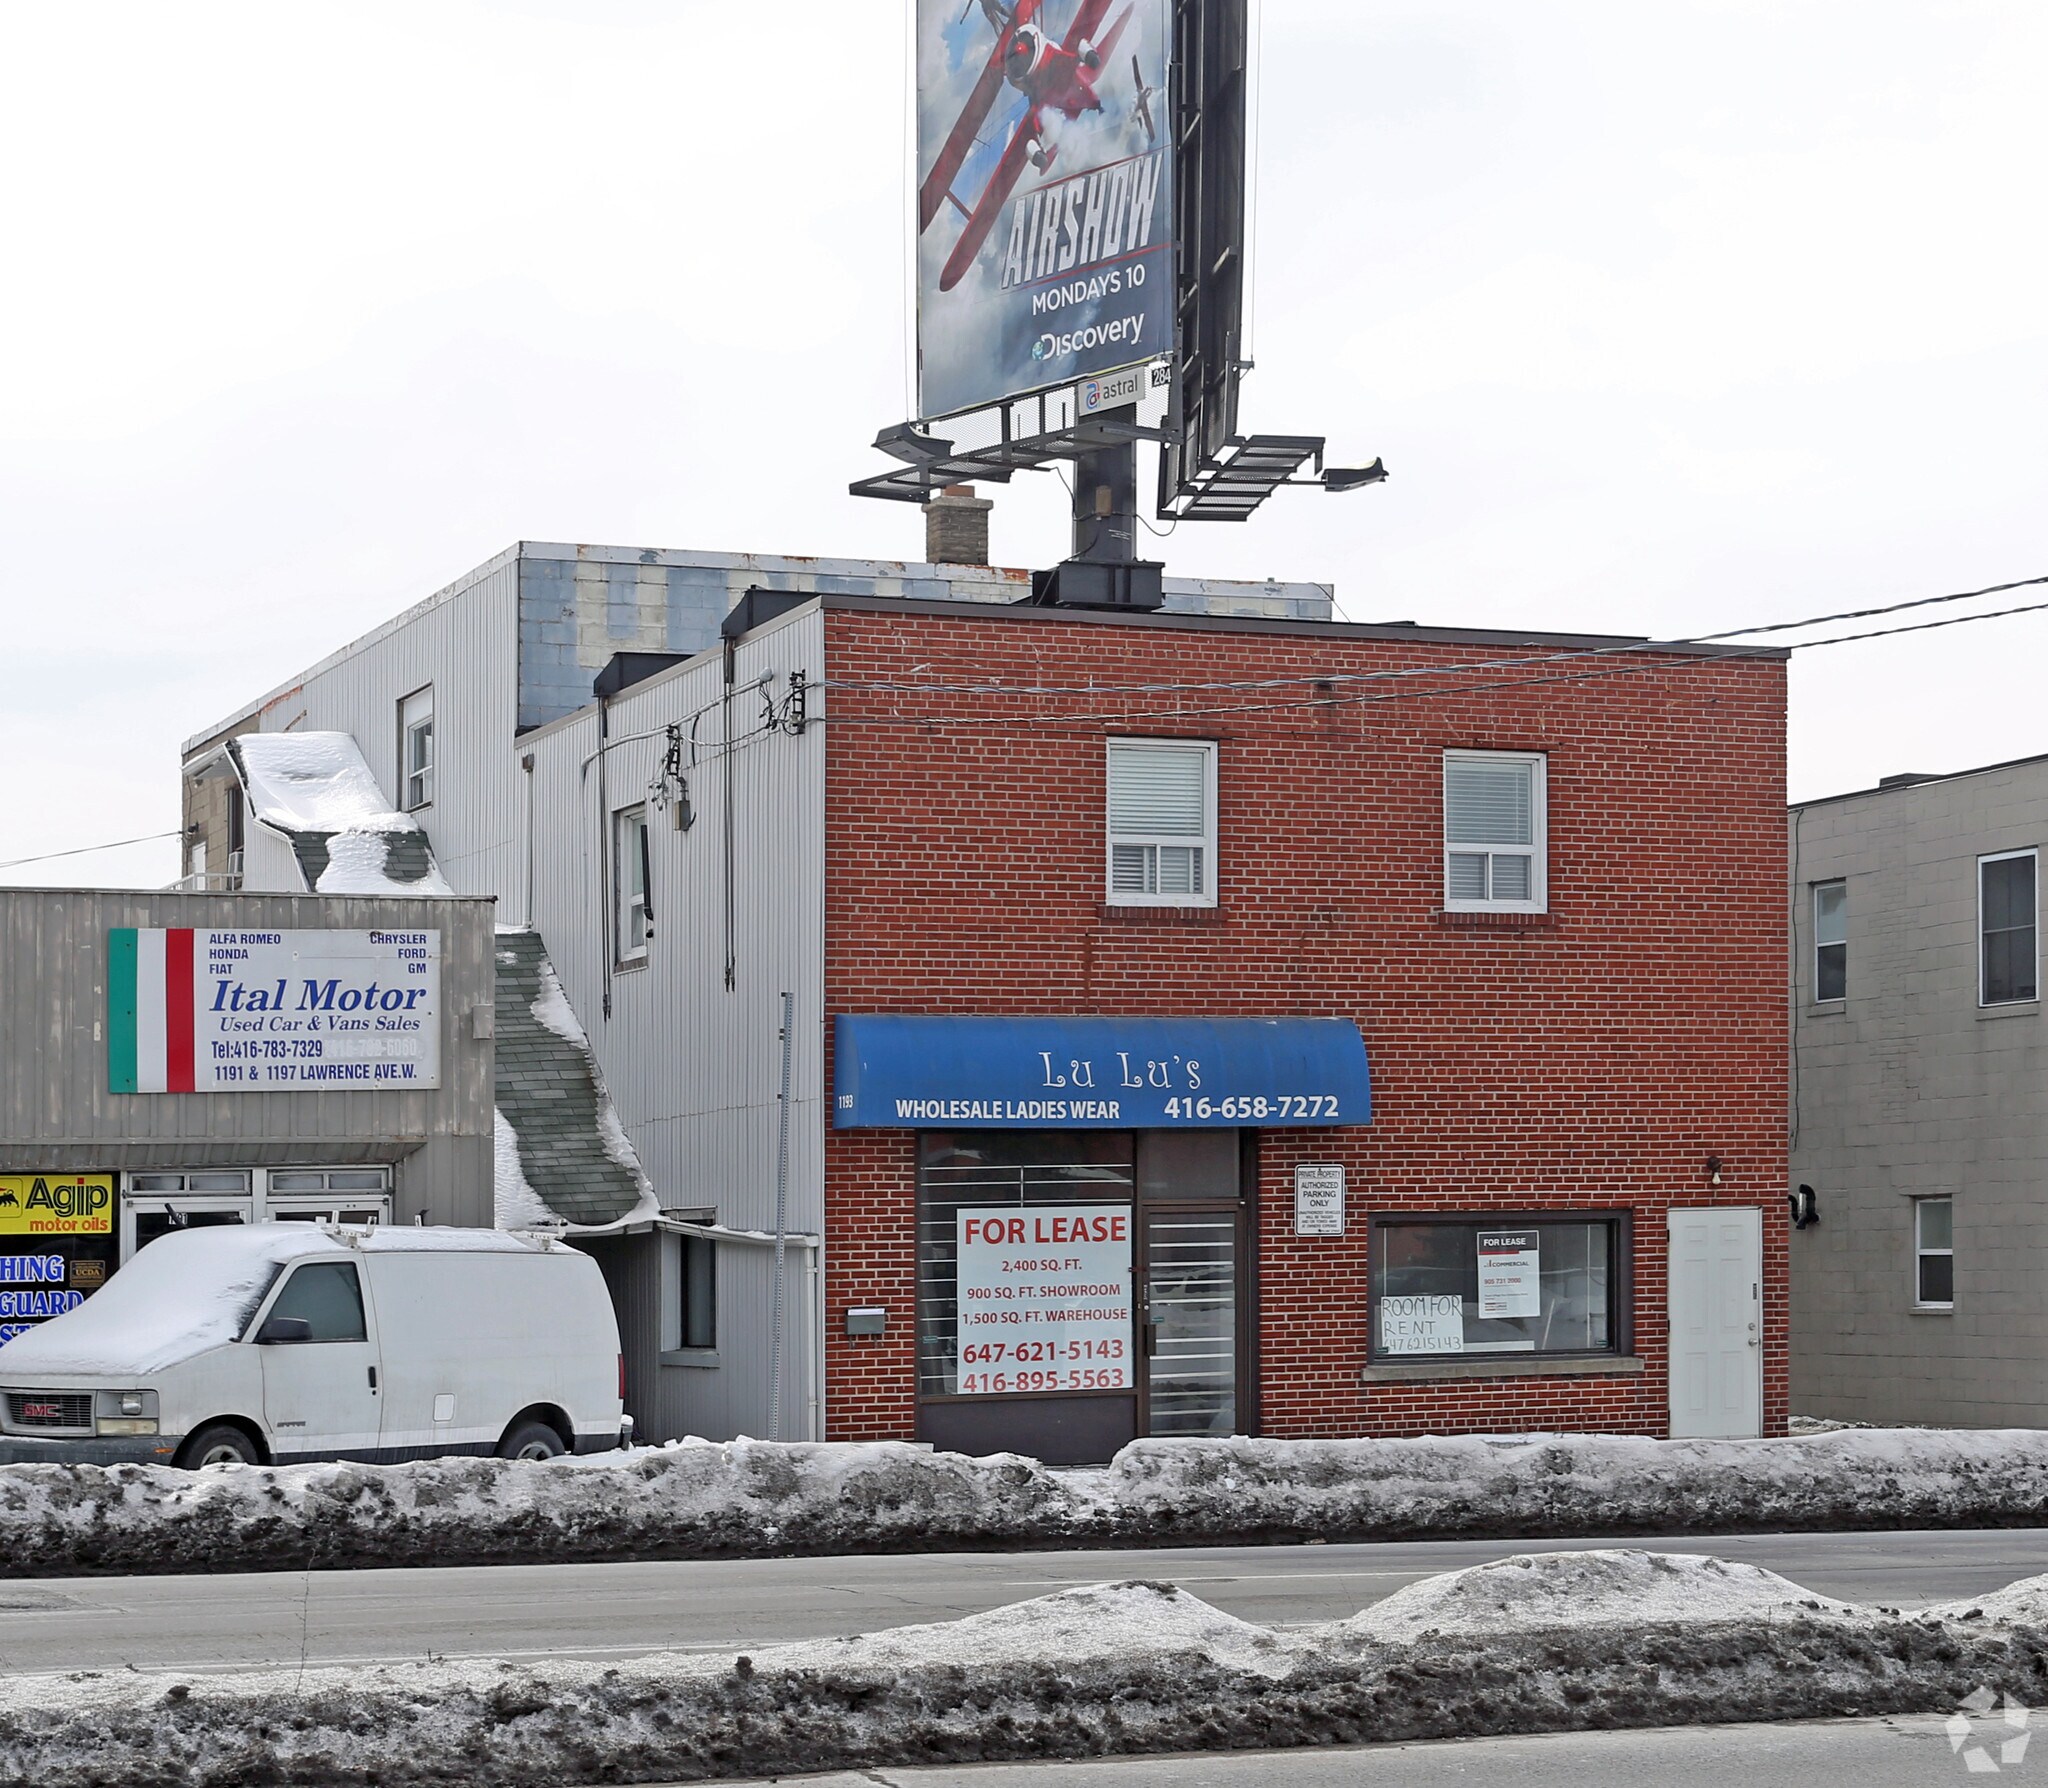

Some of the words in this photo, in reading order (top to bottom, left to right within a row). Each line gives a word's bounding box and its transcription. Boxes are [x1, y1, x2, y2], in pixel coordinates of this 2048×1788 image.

[1001, 153, 1162, 289] AIRSHOW
[1032, 270, 1121, 316] MONDAYS
[1125, 263, 1146, 289] 10
[1040, 313, 1145, 361] Discovery
[1153, 366, 1171, 386] 284
[1103, 374, 1138, 399] astral
[209, 933, 236, 944] ALFA
[240, 933, 281, 944] ROMEO
[370, 934, 427, 944] CHRYSLER
[209, 948, 249, 959] HONDA
[397, 948, 426, 958] FORD
[209, 963, 233, 974] FIAT
[408, 963, 427, 974] GM
[208, 979, 287, 1011] Ital
[295, 979, 427, 1011] Motor
[220, 1016, 264, 1031] Used
[269, 1016, 303, 1031] Car
[307, 1015, 322, 1031] &
[327, 1015, 370, 1031] Vans
[374, 1015, 420, 1031] Sales
[211, 1040, 323, 1058] Tel:416-783-7329
[214, 1066, 243, 1080] 1191
[249, 1066, 258, 1080] &
[267, 1066, 296, 1080] 1197
[300, 1064, 370, 1080] LAWRENCE
[374, 1063, 417, 1079] AVE.W.
[1038, 1051, 1095, 1088] Lu
[1116, 1052, 1201, 1090] Lu's
[838, 1094, 854, 1109] 1193
[895, 1099, 1003, 1119] WHOLESALE
[1006, 1100, 1067, 1119] LADIES
[1069, 1101, 1120, 1119] WEAR
[1164, 1095, 1339, 1119] 416-658-7272
[1301, 1181, 1338, 1189] AUTHORIZED
[25, 1177, 108, 1217] Agip
[1303, 1190, 1336, 1198] PARKING
[1309, 1199, 1329, 1207] ONLY
[30, 1219, 78, 1232] motor
[82, 1217, 108, 1231] oils
[965, 1218, 1026, 1245] FOR
[1035, 1216, 1126, 1243] LEASE
[1483, 1238, 1500, 1247] FOR
[1501, 1237, 1526, 1246] LEASE
[1001, 1260, 1037, 1273] 2,400
[1040, 1259, 1062, 1272] SQ.
[1064, 1258, 1082, 1271] FT.
[967, 1288, 991, 1300] 900
[994, 1287, 1015, 1300] SQ.
[1019, 1286, 1036, 1298] FT.
[1040, 1284, 1120, 1297] SHOWROOM
[1382, 1297, 1426, 1317] ROOM
[1430, 1295, 1463, 1317] FOR
[962, 1313, 998, 1326] 1,500
[1000, 1312, 1022, 1325] SQ.
[1025, 1311, 1043, 1323] FT.
[1046, 1308, 1128, 1322] WAREHOUSE
[1384, 1321, 1436, 1337] RENT
[963, 1339, 1124, 1364] 647-621-5143
[963, 1368, 1124, 1393] 416-895-5563
[24, 1404, 59, 1417] GMC
